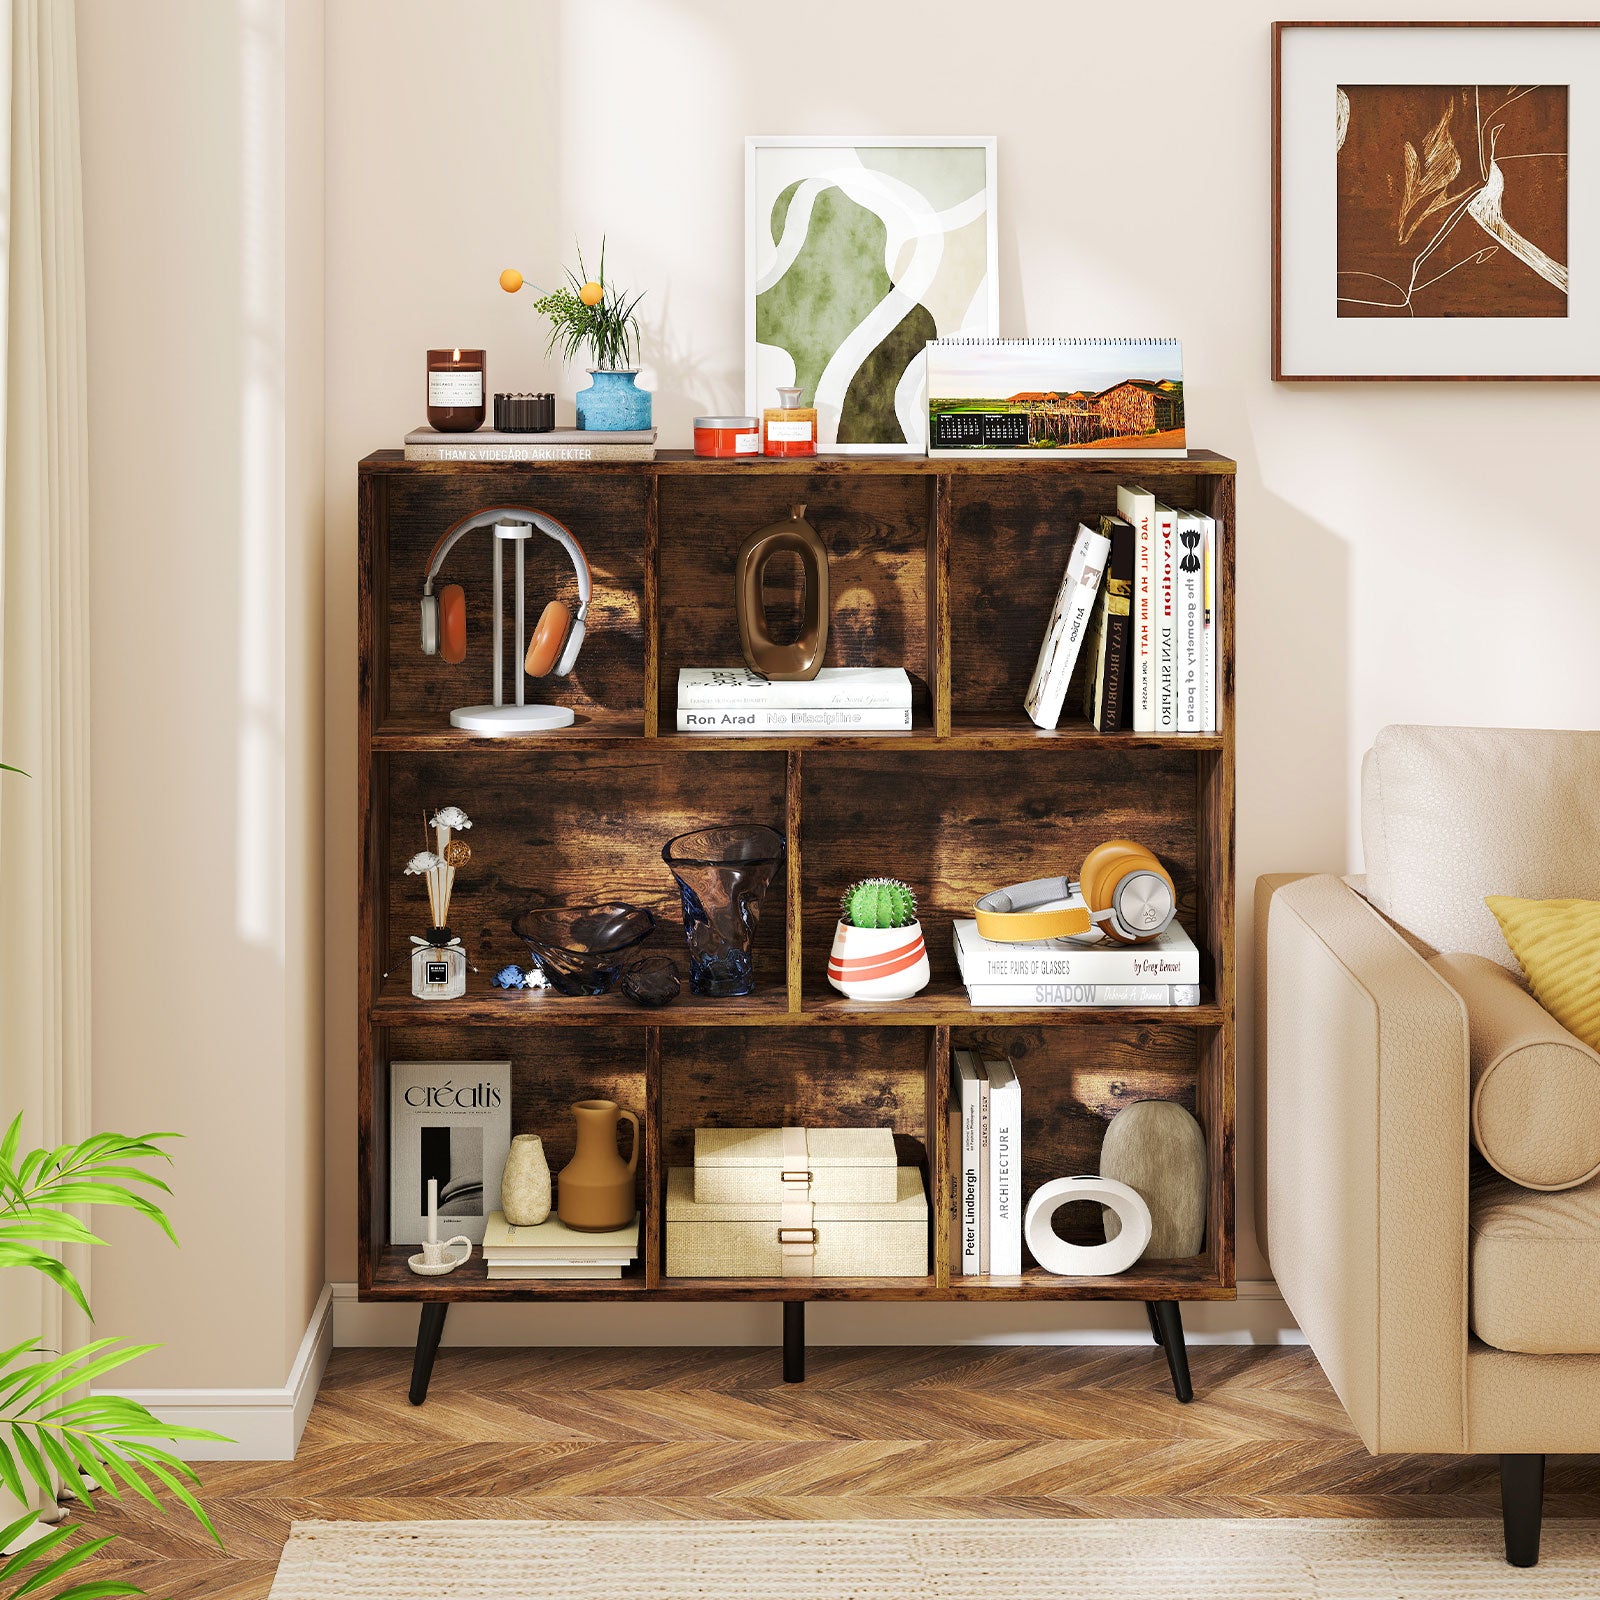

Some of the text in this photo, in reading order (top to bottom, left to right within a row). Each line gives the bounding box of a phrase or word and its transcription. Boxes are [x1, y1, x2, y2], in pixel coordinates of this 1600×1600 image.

[439, 448, 592, 460] THAM & VIDEGÅRD ARKITEKTER
[686, 712, 862, 726] Ron Arad No Discipline
[988, 960, 1070, 975] THREE PAIRS OF GLASSES
[1134, 959, 1142, 976] by
[1143, 959, 1158, 977] Greg
[1035, 985, 1096, 1003] SHADOW
[405, 1080, 501, 1108] créatis
[999, 1127, 1009, 1220] ARCHITECTURE
[965, 1168, 977, 1256] Peter Lindbergh
